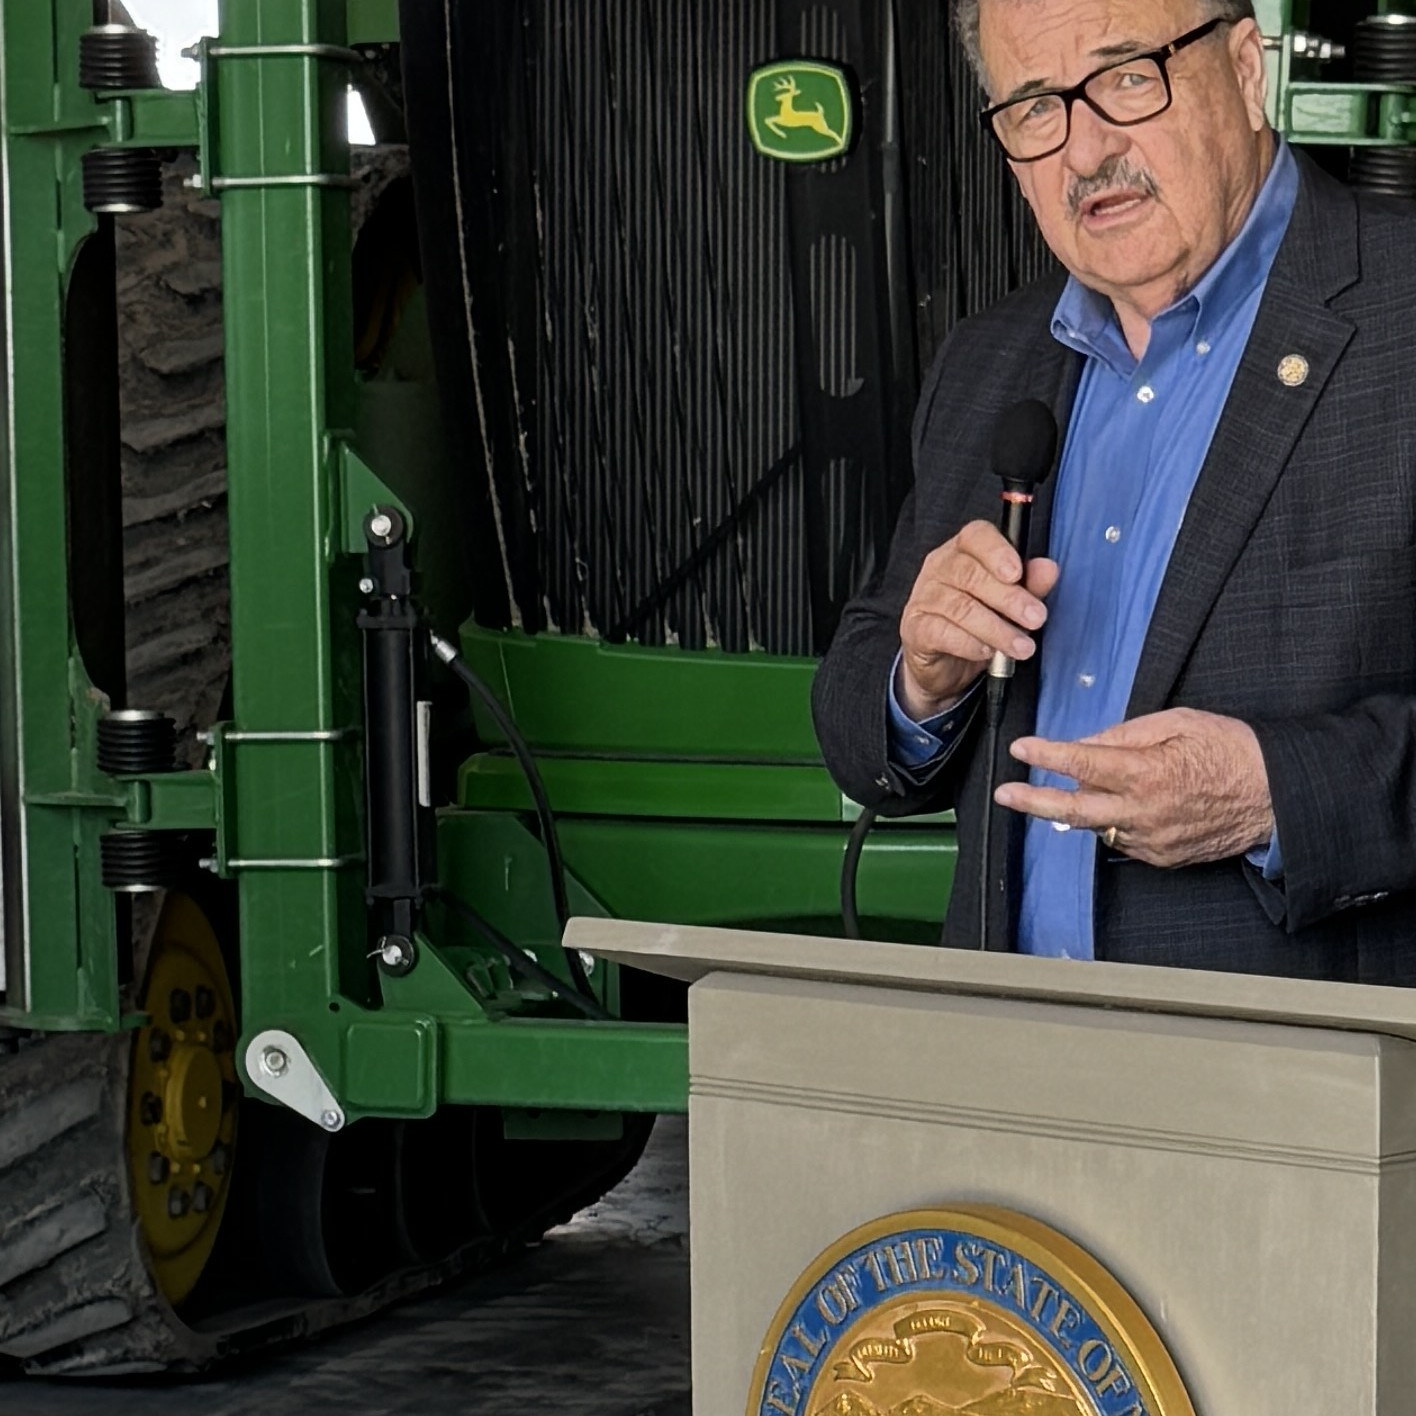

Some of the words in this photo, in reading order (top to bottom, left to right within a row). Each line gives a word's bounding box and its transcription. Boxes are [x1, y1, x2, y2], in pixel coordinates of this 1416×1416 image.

[815, 1264, 862, 1326] OF
[857, 1236, 944, 1293] THE
[952, 1241, 1086, 1350] STATE
[1077, 1338, 1132, 1398] OF
